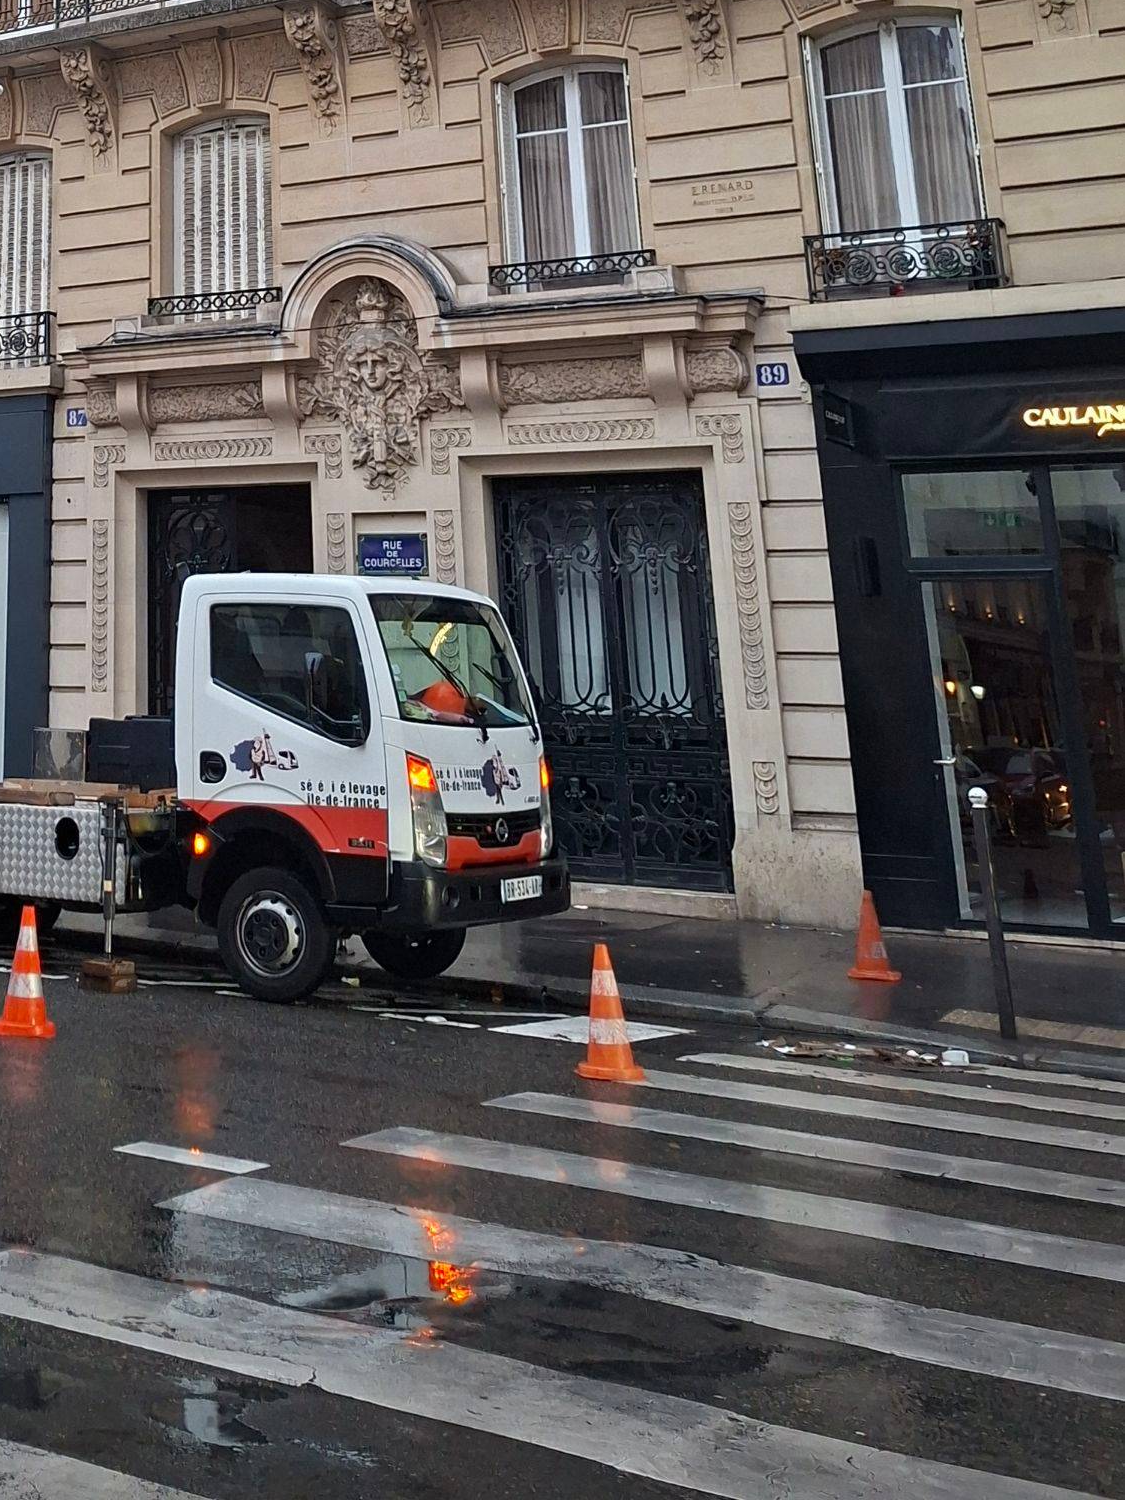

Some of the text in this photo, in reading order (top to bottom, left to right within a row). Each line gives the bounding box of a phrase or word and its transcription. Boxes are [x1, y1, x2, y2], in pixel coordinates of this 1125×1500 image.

[761, 364, 785, 384] 89
[69, 410, 85, 425] 87
[1023, 405, 1125, 427] CAULAIN
[382, 540, 403, 550] RUE
[386, 550, 399, 558] DE
[364, 558, 422, 567] COURCELLES
